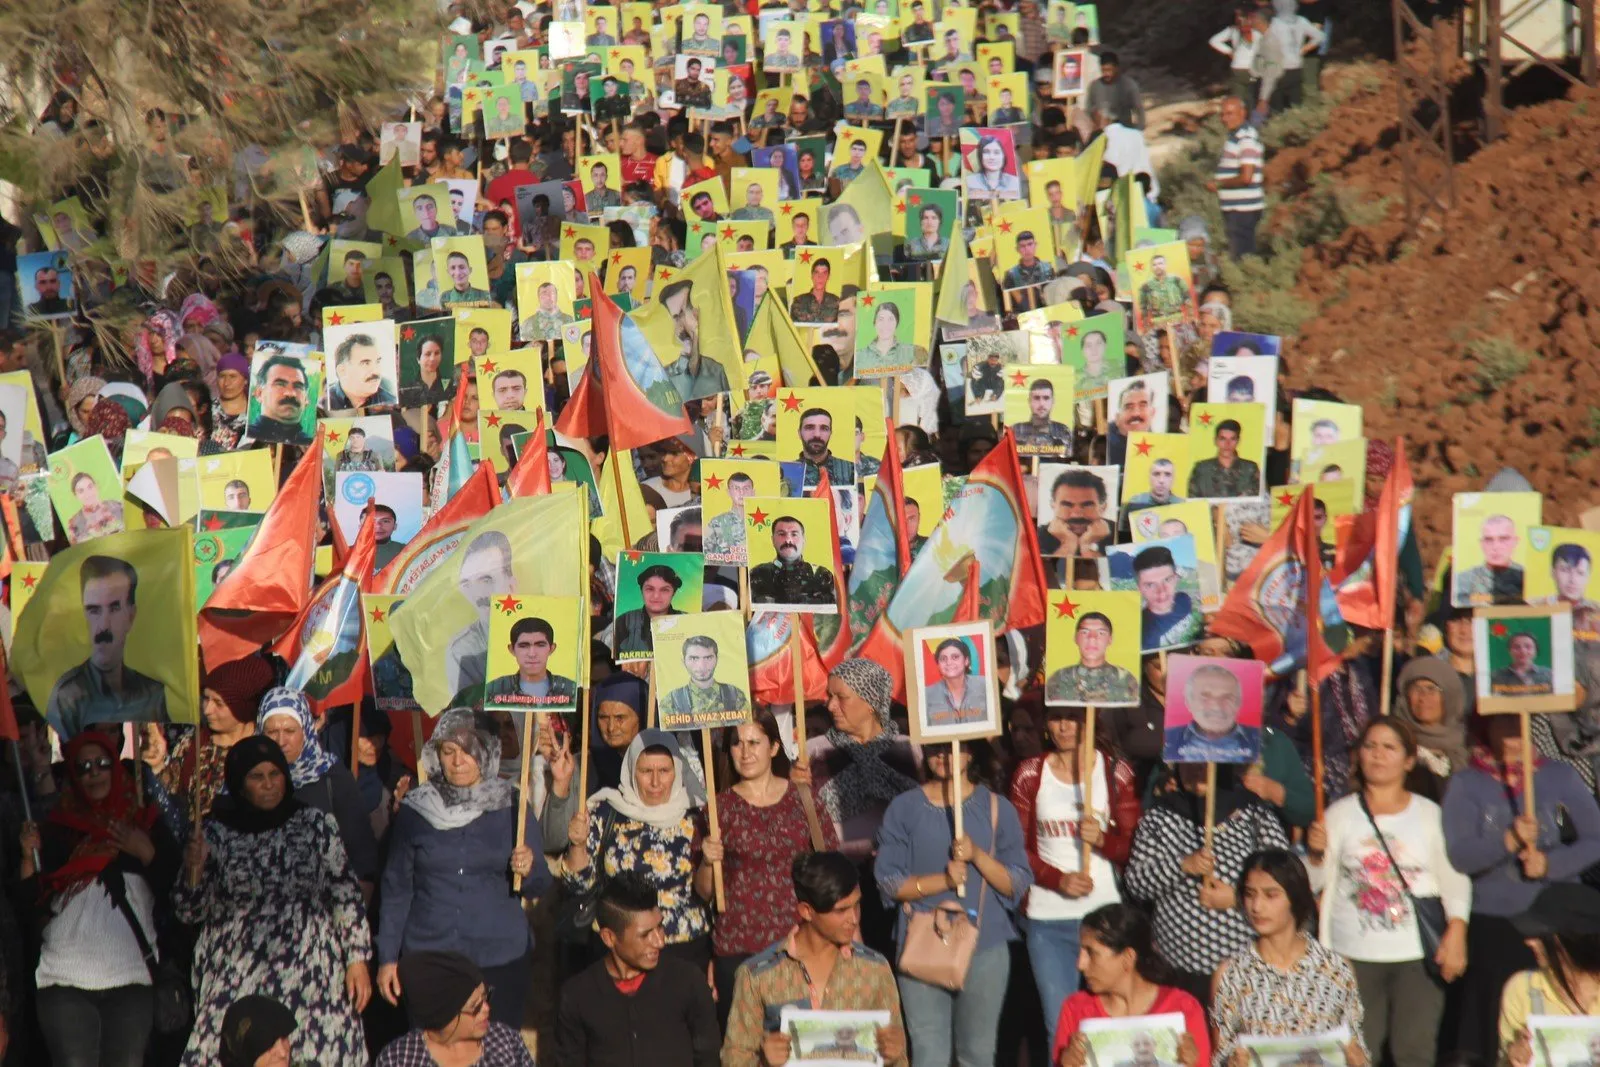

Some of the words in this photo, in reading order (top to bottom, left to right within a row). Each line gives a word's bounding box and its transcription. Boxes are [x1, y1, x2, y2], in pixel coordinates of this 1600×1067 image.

[619, 650, 654, 660] PAKREW
[693, 712, 718, 723] AWAZ
[720, 710, 748, 720] XEBAT
